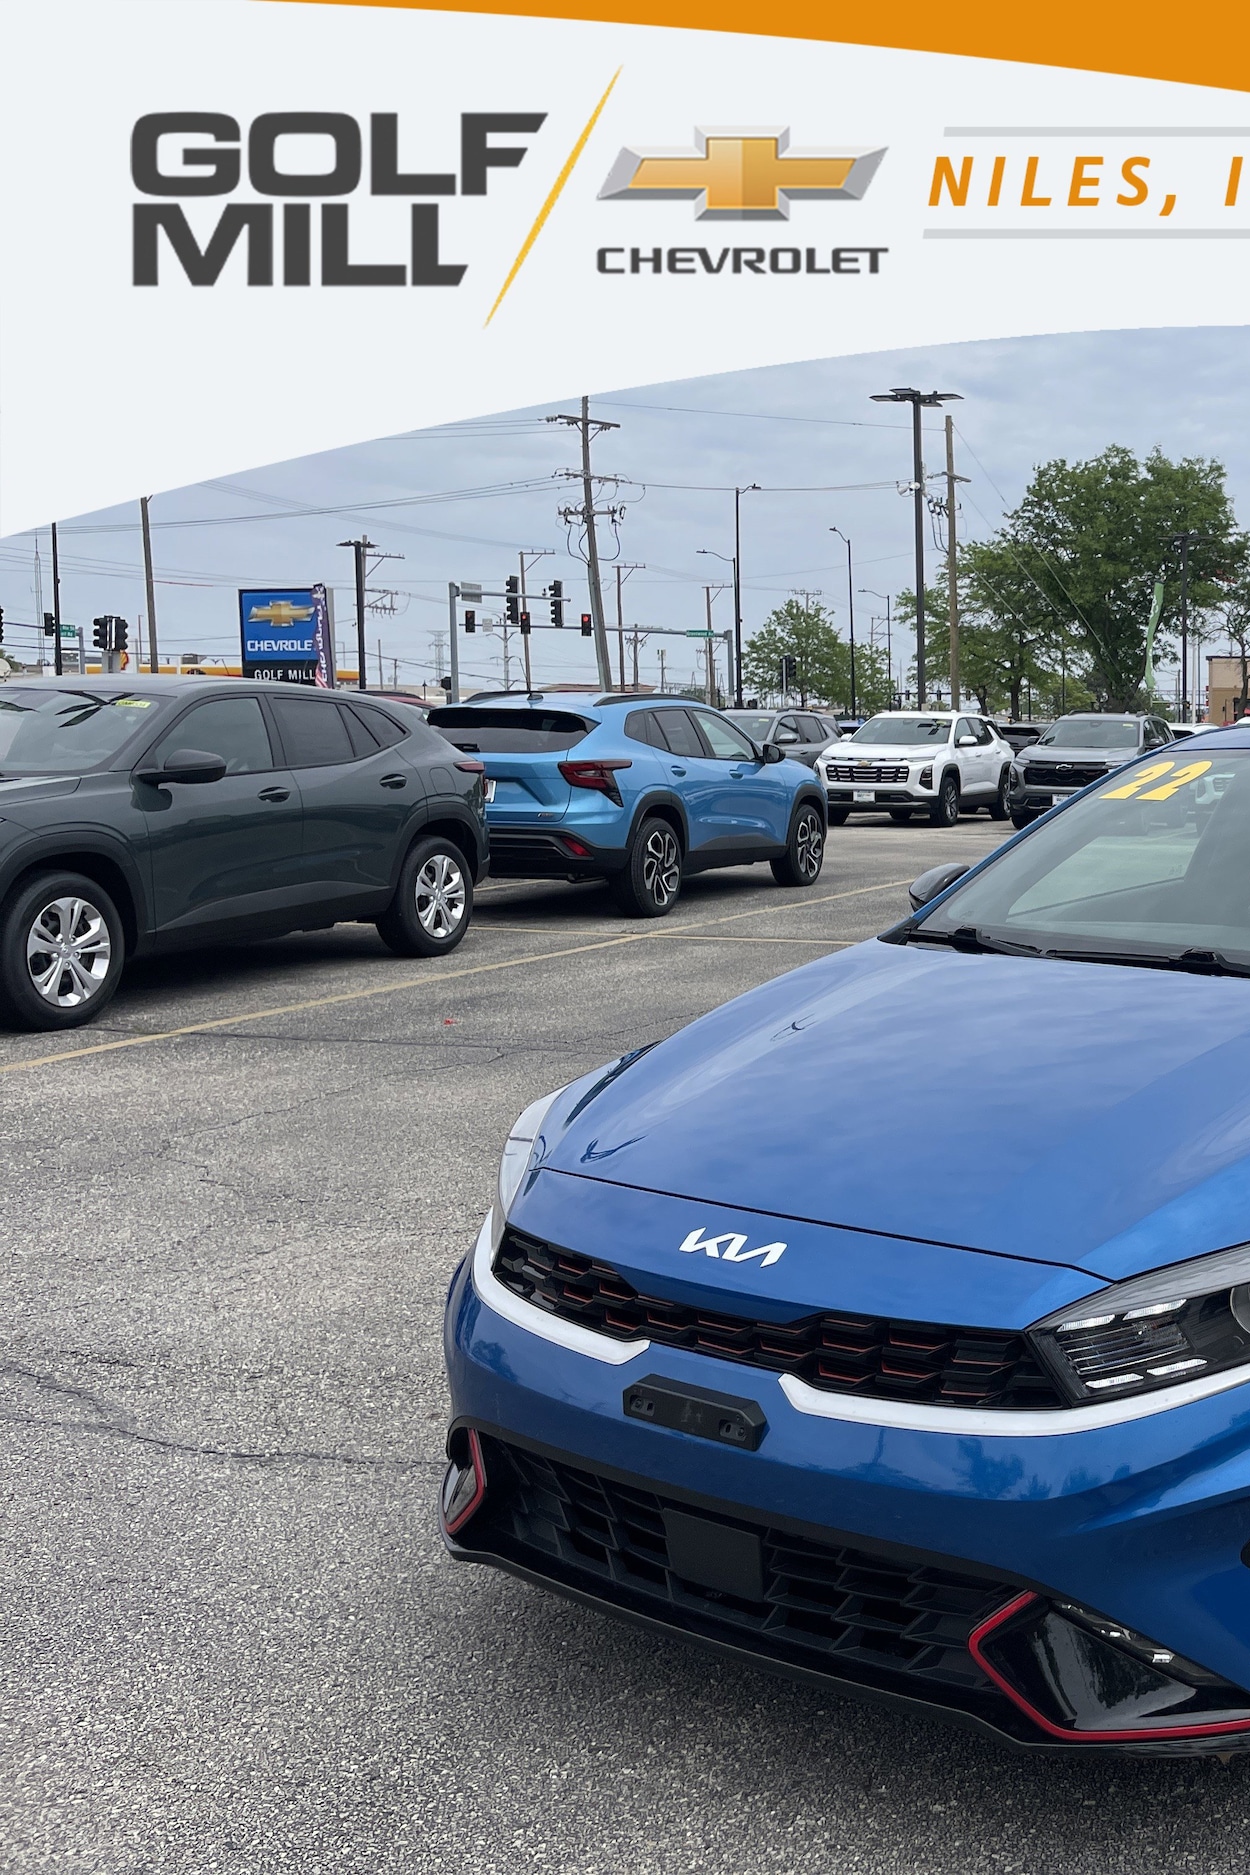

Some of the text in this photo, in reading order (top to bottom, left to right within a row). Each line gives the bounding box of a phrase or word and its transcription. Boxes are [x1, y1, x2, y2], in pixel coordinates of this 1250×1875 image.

[247, 639, 313, 652] CHEVROLE
[254, 669, 315, 680] GOLF MILL
[1099, 760, 1213, 802] 22
[678, 1226, 788, 1268] KIA
